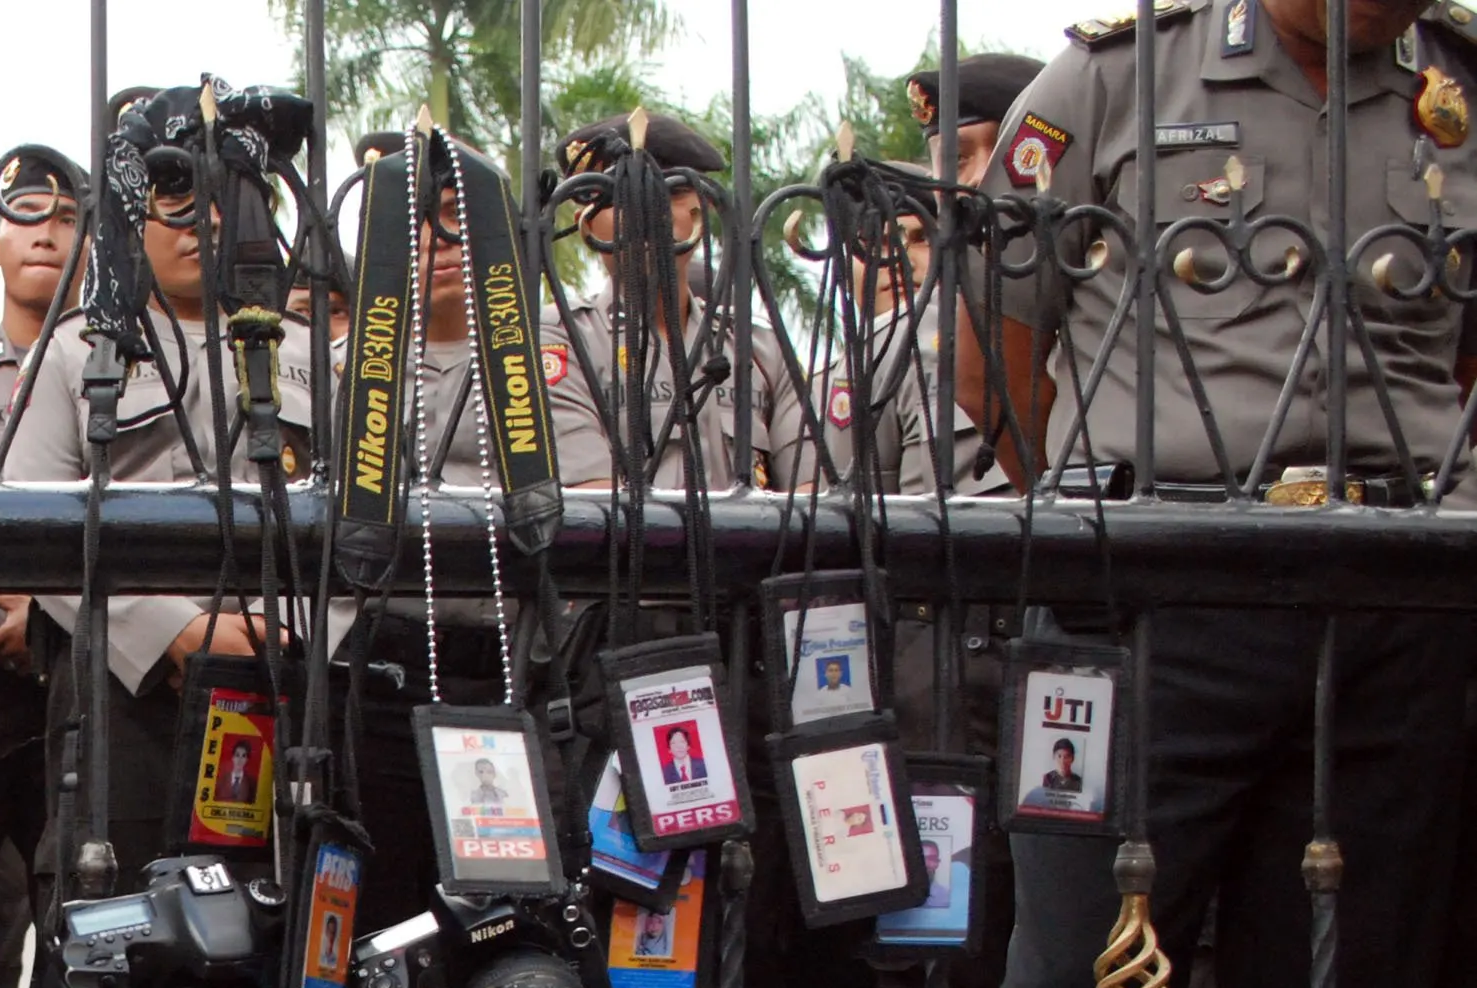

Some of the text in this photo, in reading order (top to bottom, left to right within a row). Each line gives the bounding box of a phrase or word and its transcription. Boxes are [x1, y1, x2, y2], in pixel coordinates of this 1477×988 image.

[1025, 114, 1067, 143] SABHARA
[1157, 127, 1226, 144] AFRIZAL
[484, 263, 537, 454] Nikon D300s
[356, 295, 400, 494] Nikon D300s
[200, 715, 223, 803] PERS
[657, 804, 734, 831] PERS
[813, 780, 842, 874] PERS
[917, 816, 950, 831] ERS
[462, 840, 535, 858] PERS
[320, 851, 357, 892] PERS
[471, 919, 514, 943] Nikon
